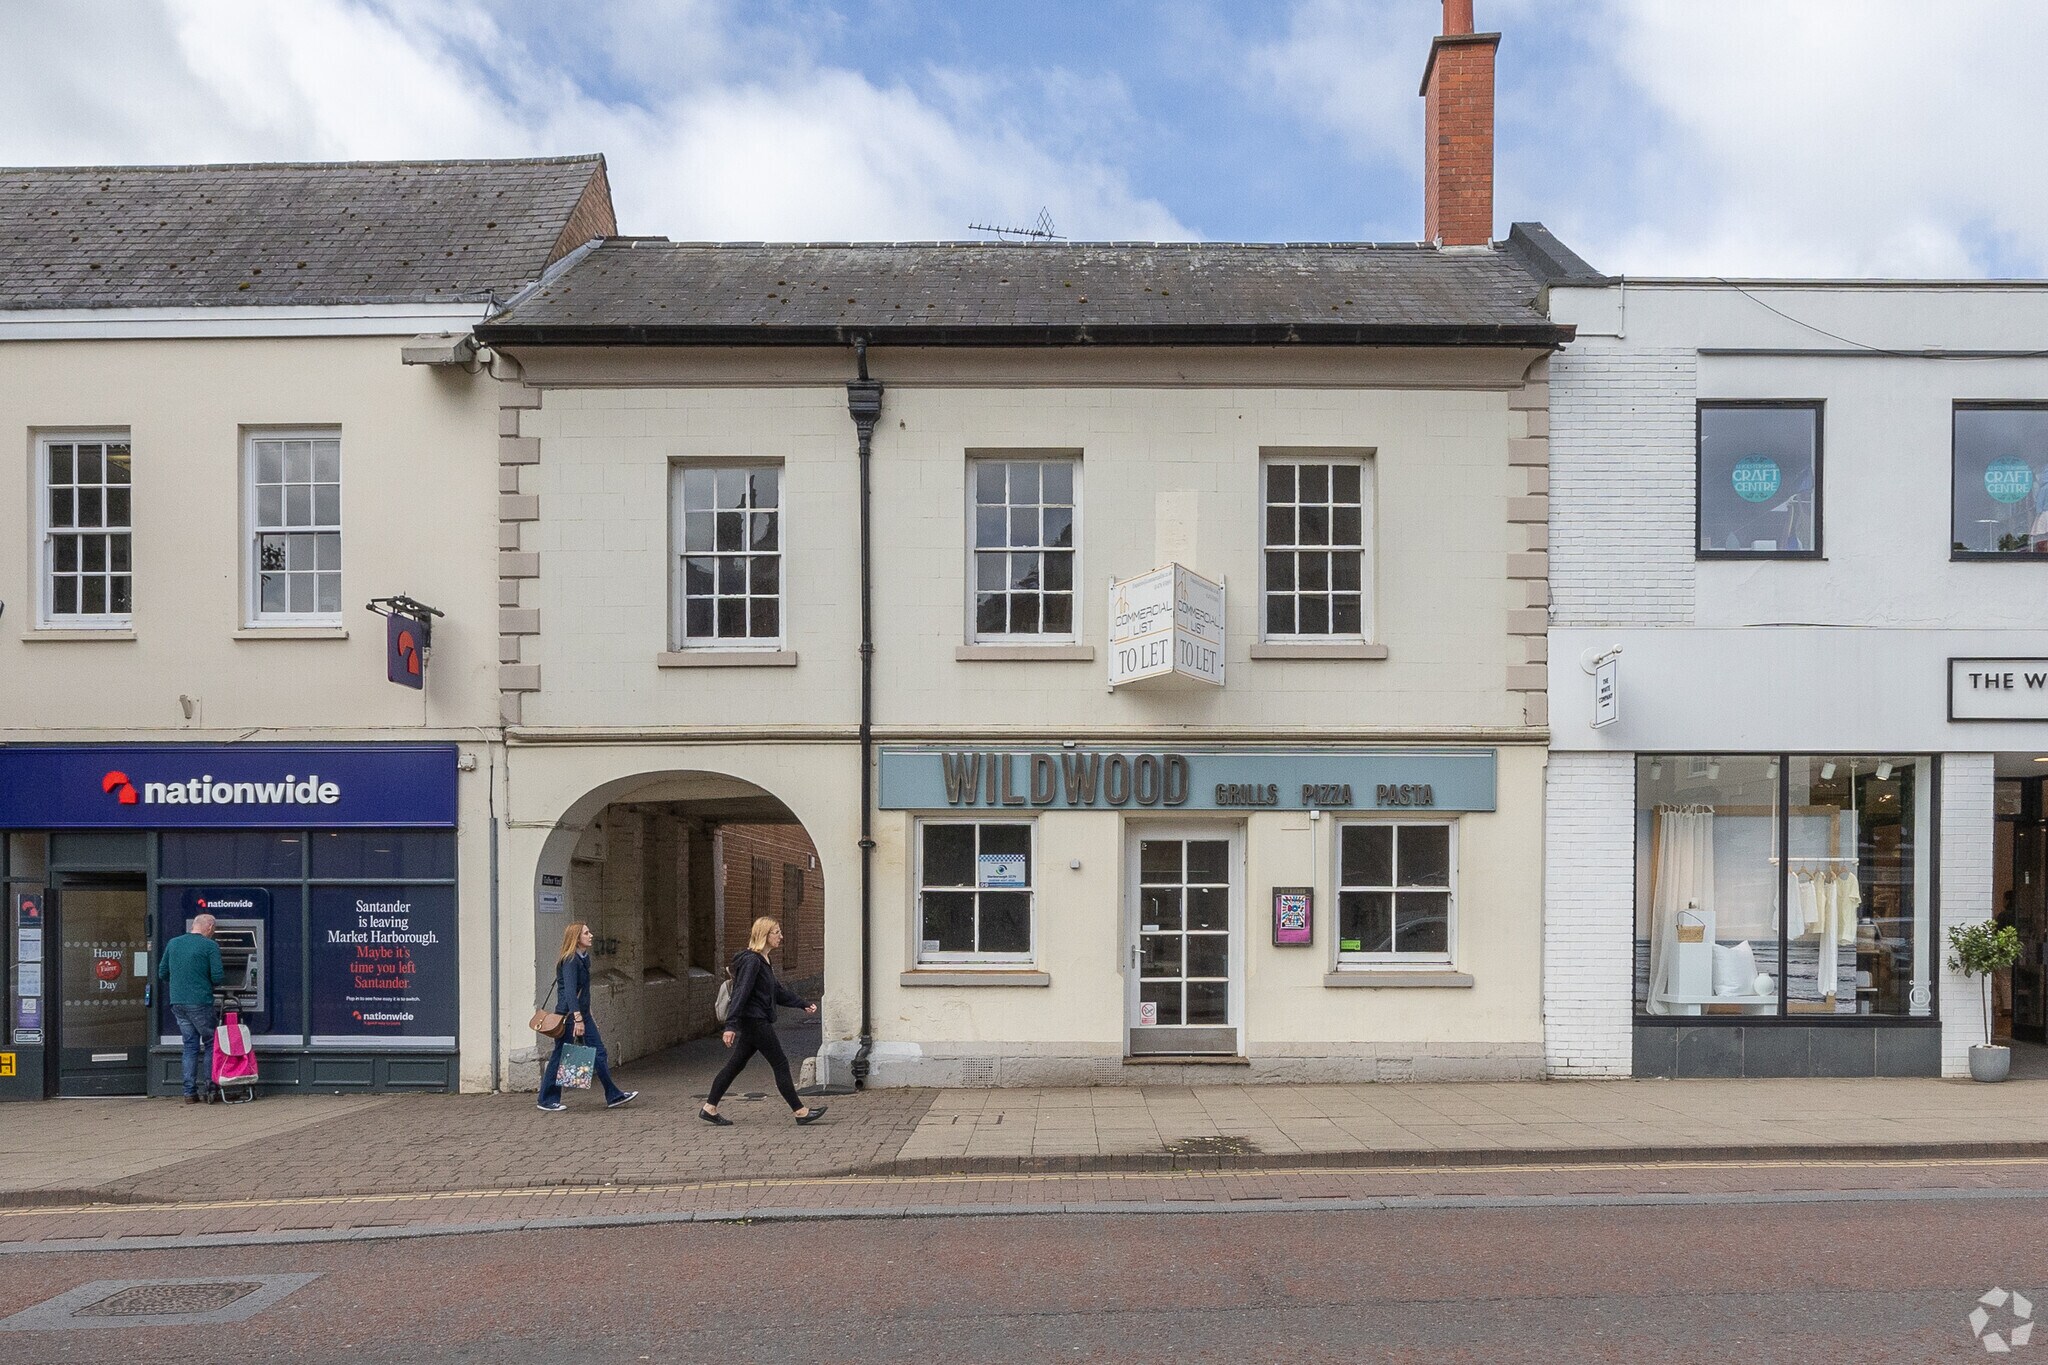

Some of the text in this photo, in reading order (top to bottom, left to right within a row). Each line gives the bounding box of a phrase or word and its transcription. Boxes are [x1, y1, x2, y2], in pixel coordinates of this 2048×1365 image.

[1732, 469, 1780, 481] CRAFT
[1985, 471, 2032, 483] CRAFT
[1735, 481, 1778, 492] CENTRE
[1987, 483, 2030, 493] CENTRE
[1116, 600, 1172, 627] COMMERCIAL
[1178, 599, 1220, 628] COMMERCIAL
[1133, 619, 1154, 636] LIST
[1191, 620, 1206, 636] LIST
[1119, 638, 1168, 674] TO LET
[1180, 639, 1217, 674] TO LET
[1968, 673, 2014, 689] THE
[941, 753, 1433, 806] WILDWOOD GRILLS PIZZA PASTA
[144, 774, 341, 804] nationwide
[207, 899, 253, 908] nationwide
[356, 899, 411, 913] Santander
[358, 915, 409, 931] is leaving
[327, 930, 439, 946] Market Harborough.
[93, 948, 123, 960] Happy
[356, 945, 393, 960] Maybe
[350, 960, 416, 976] time you left
[99, 980, 118, 991] Day
[354, 975, 412, 989] Santander.
[363, 1012, 414, 1021] nationwide
